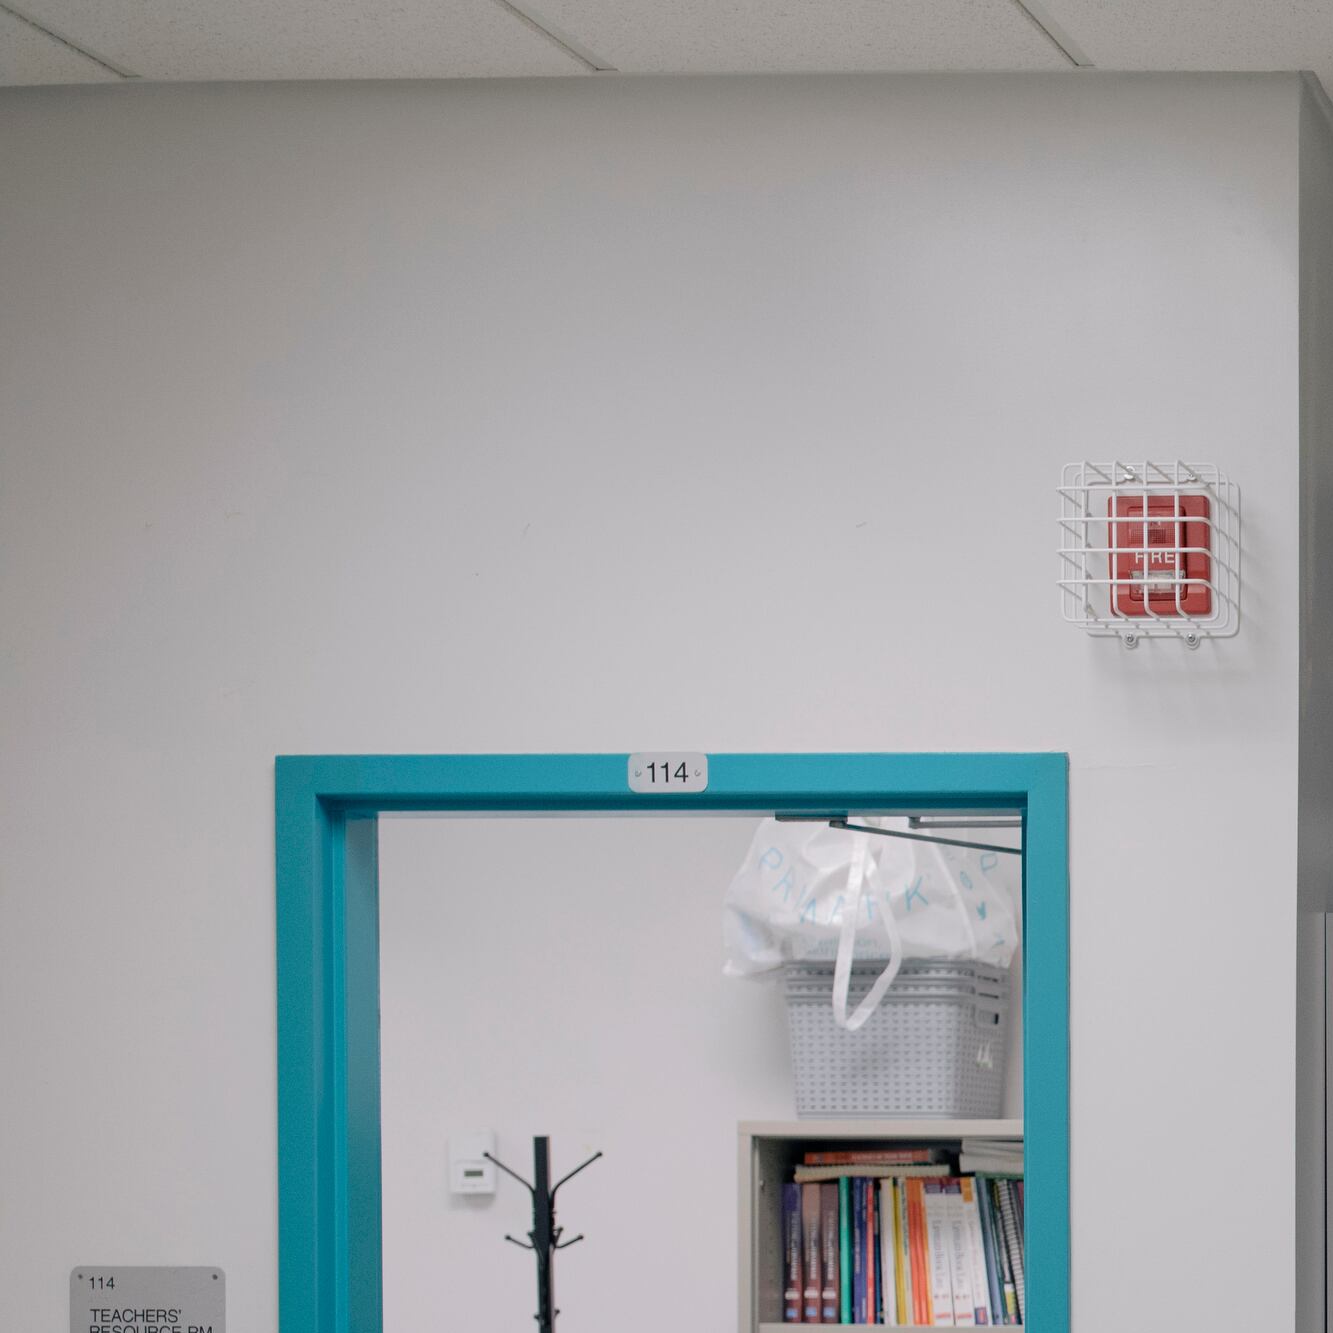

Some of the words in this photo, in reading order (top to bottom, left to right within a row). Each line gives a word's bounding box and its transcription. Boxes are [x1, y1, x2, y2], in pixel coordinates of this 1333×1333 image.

[1135, 552, 1174, 563] FRE
[647, 762, 688, 782] 114
[89, 1277, 115, 1289] 114
[90, 1309, 181, 1322] TEACHERS'
